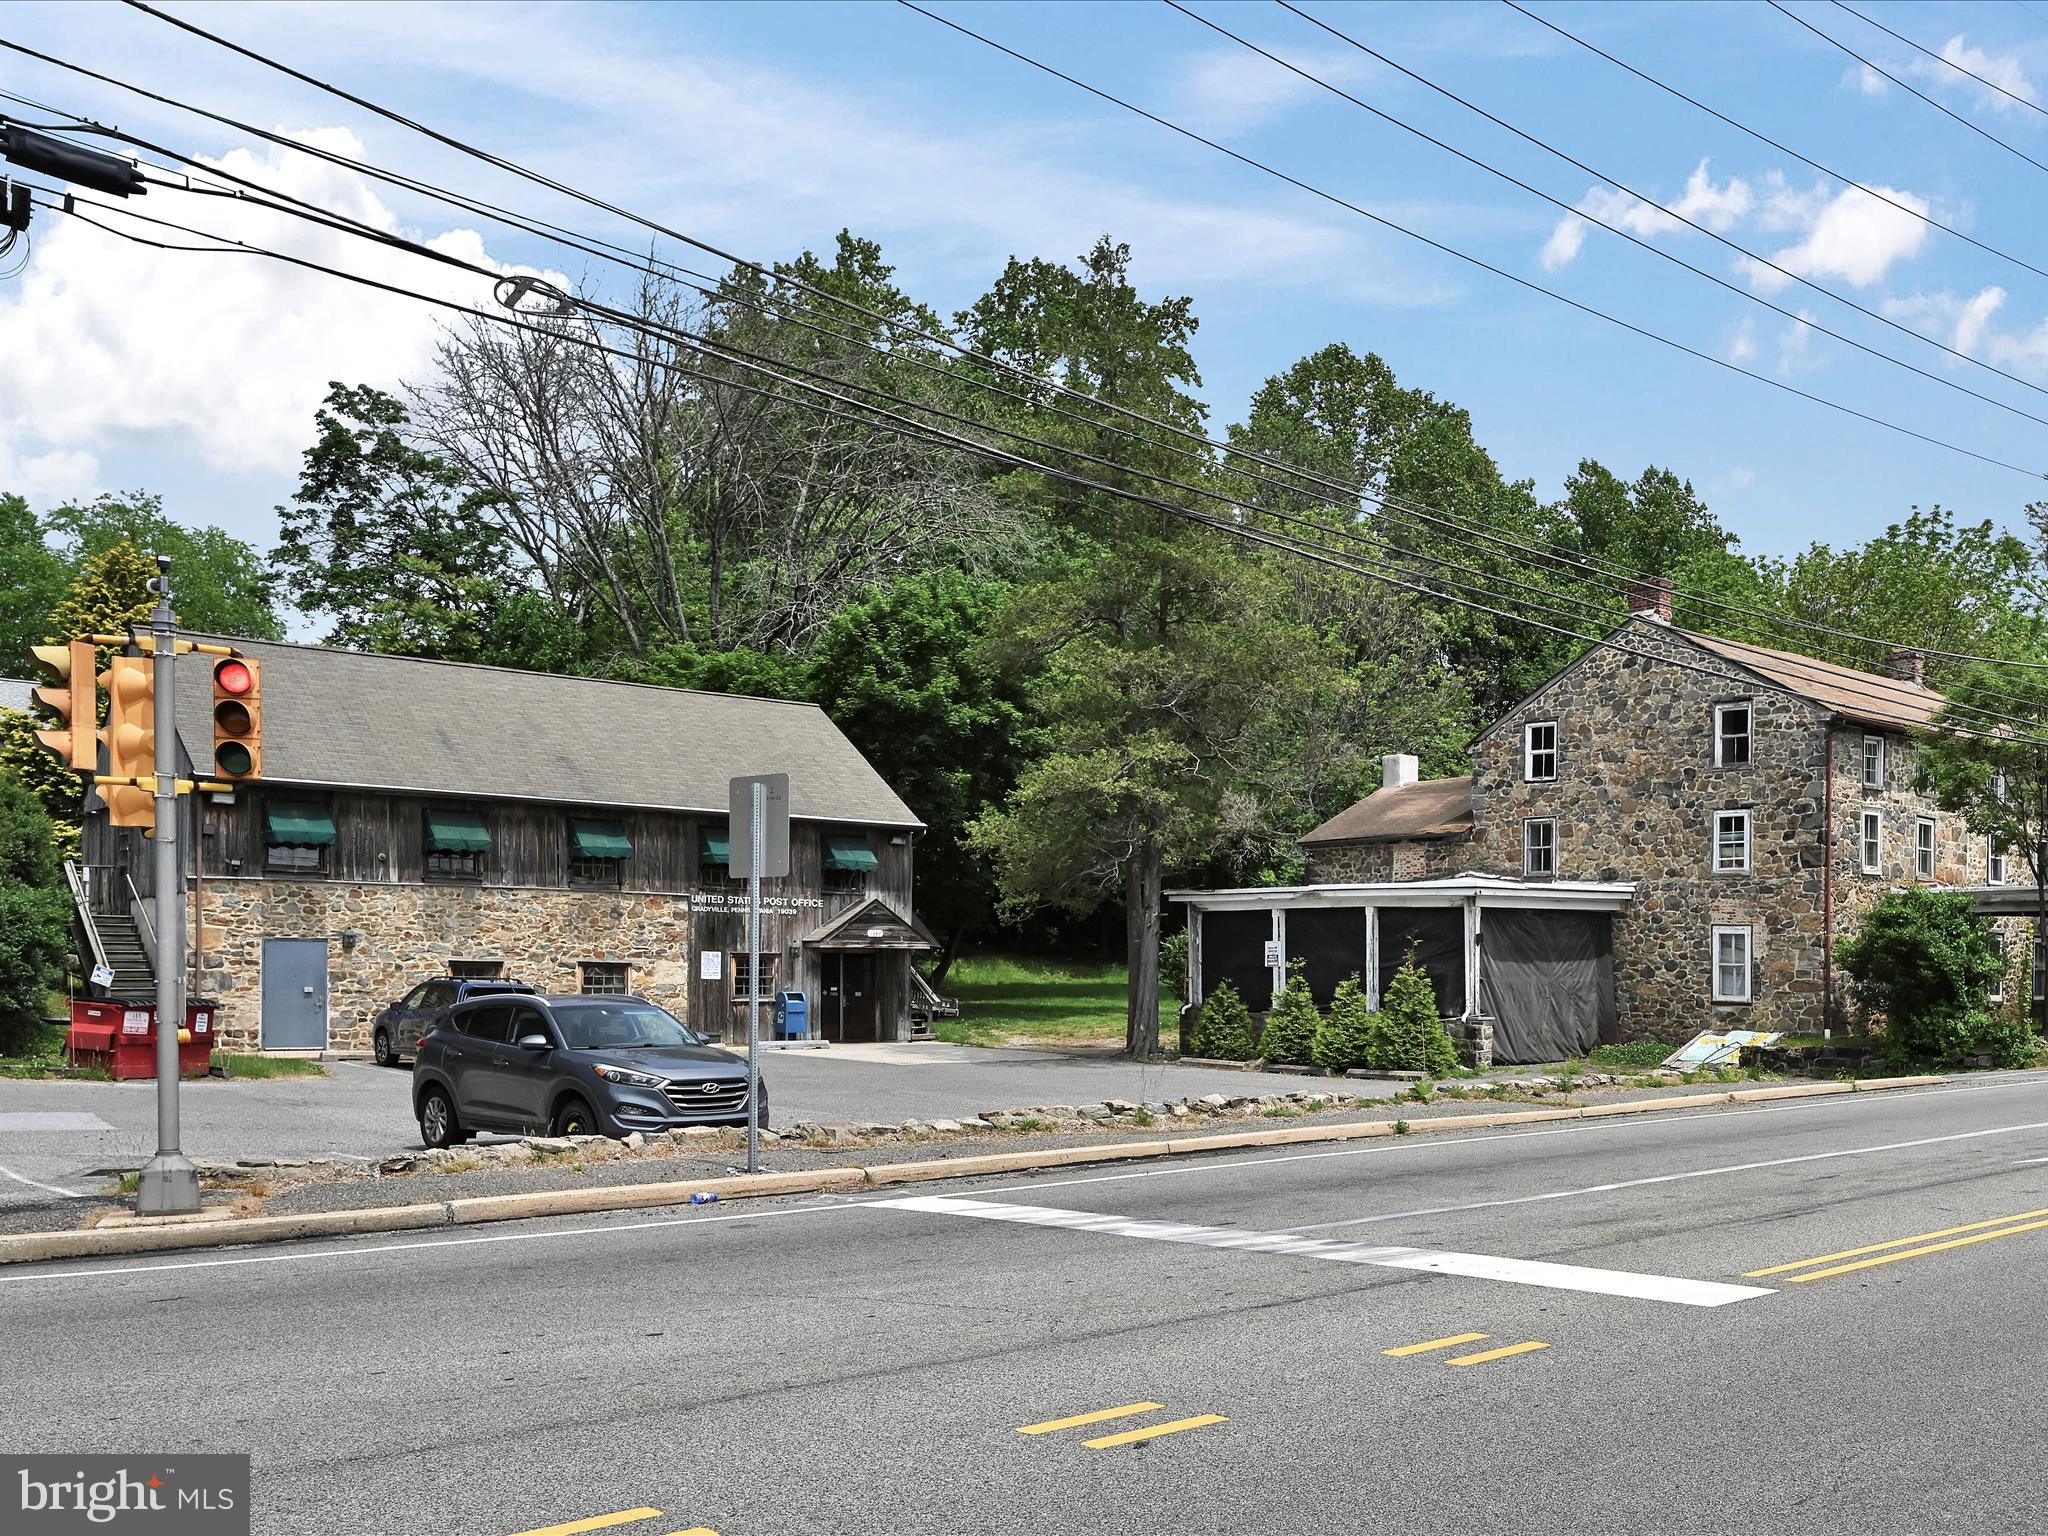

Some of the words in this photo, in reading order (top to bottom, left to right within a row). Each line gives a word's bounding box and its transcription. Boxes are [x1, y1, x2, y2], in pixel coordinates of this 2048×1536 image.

[691, 894, 724, 904] UNITED
[727, 895, 761, 905] STAT
[763, 896, 789, 906] POST
[791, 898, 824, 908] OFFICE
[730, 906, 773, 914] PENNSANIA
